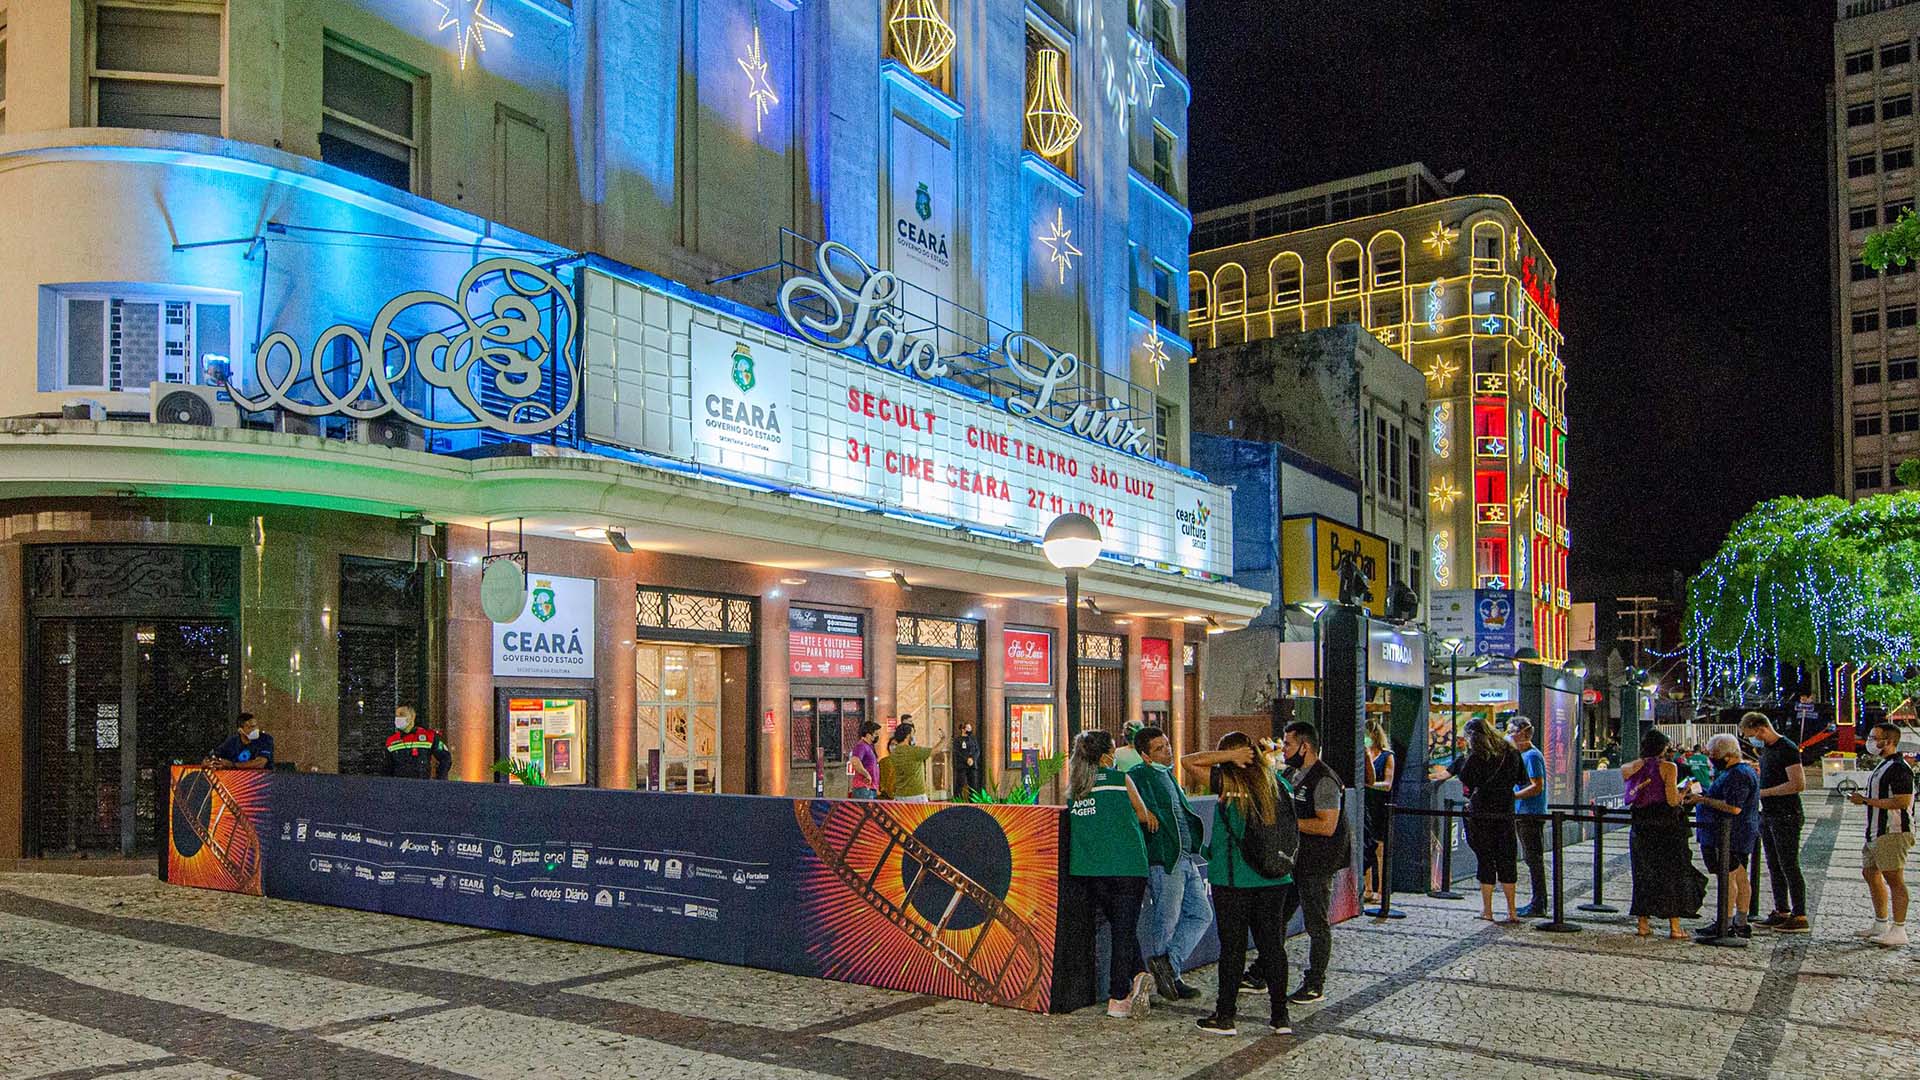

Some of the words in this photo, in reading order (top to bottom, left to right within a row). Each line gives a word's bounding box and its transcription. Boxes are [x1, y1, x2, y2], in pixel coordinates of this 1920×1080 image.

[898, 219, 949, 259] CEARÁ
[778, 240, 947, 379] São
[1003, 331, 1151, 456] Luiz
[705, 394, 781, 434] CEARÁ
[705, 418, 742, 433] GOVERNO
[743, 427, 754, 437] DO
[755, 430, 782, 443] ESTADO
[848, 386, 936, 435] SECULT
[1091, 464, 1118, 490] SÃO
[1125, 476, 1155, 500] LUIZ
[886, 450, 935, 483] CINE
[1175, 507, 1195, 526] ceará
[1181, 521, 1207, 540] cultura
[502, 628, 583, 655] CEARÁ
[800, 635, 816, 647] ARTE
[817, 637, 822, 647] E
[823, 638, 851, 649] CULTURA
[502, 654, 541, 663] GOVERNO
[555, 656, 584, 665] ESTADO
[806, 647, 823, 656] PARA
[824, 649, 845, 659] TODOS
[1382, 642, 1413, 665] ENTRADA
[1071, 806, 1096, 816] AGEFIS
[1073, 798, 1096, 808] APOIO
[457, 843, 482, 854] CEARÁ
[544, 851, 566, 864] enel
[459, 879, 485, 890] CEARÁ
[565, 888, 589, 901] Diário
